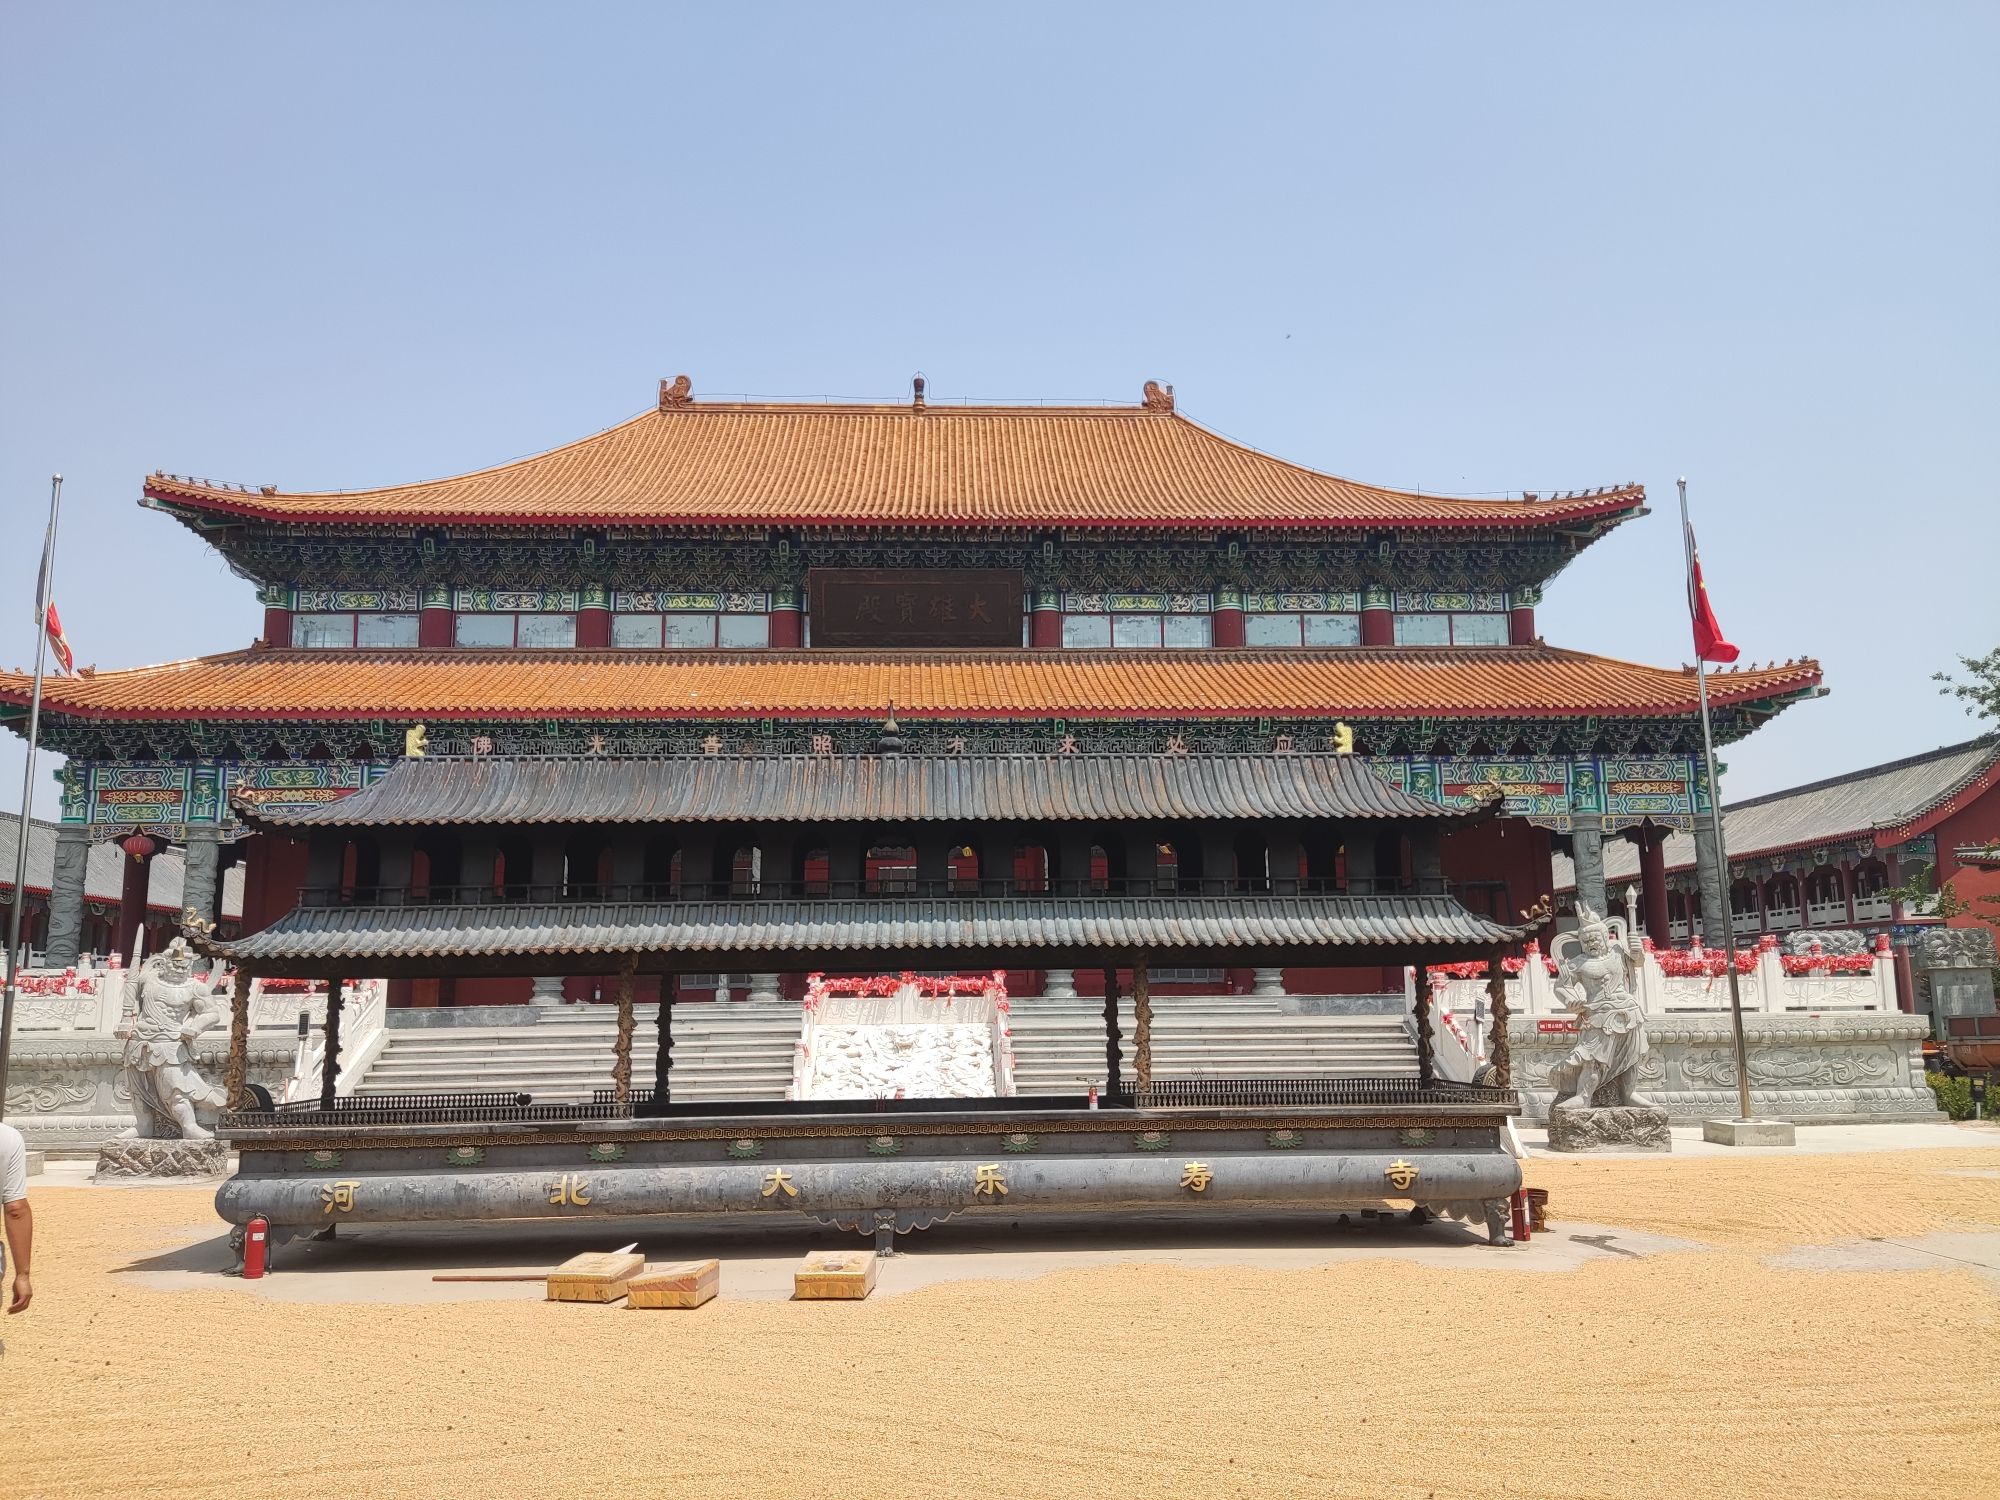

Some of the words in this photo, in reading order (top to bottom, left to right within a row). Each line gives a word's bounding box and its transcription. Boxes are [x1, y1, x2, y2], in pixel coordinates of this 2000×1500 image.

[471, 735, 833, 756] 佛光普照
[947, 734, 1297, 755] 有求必应
[321, 1159, 1420, 1215] 河北大乐寿寺
